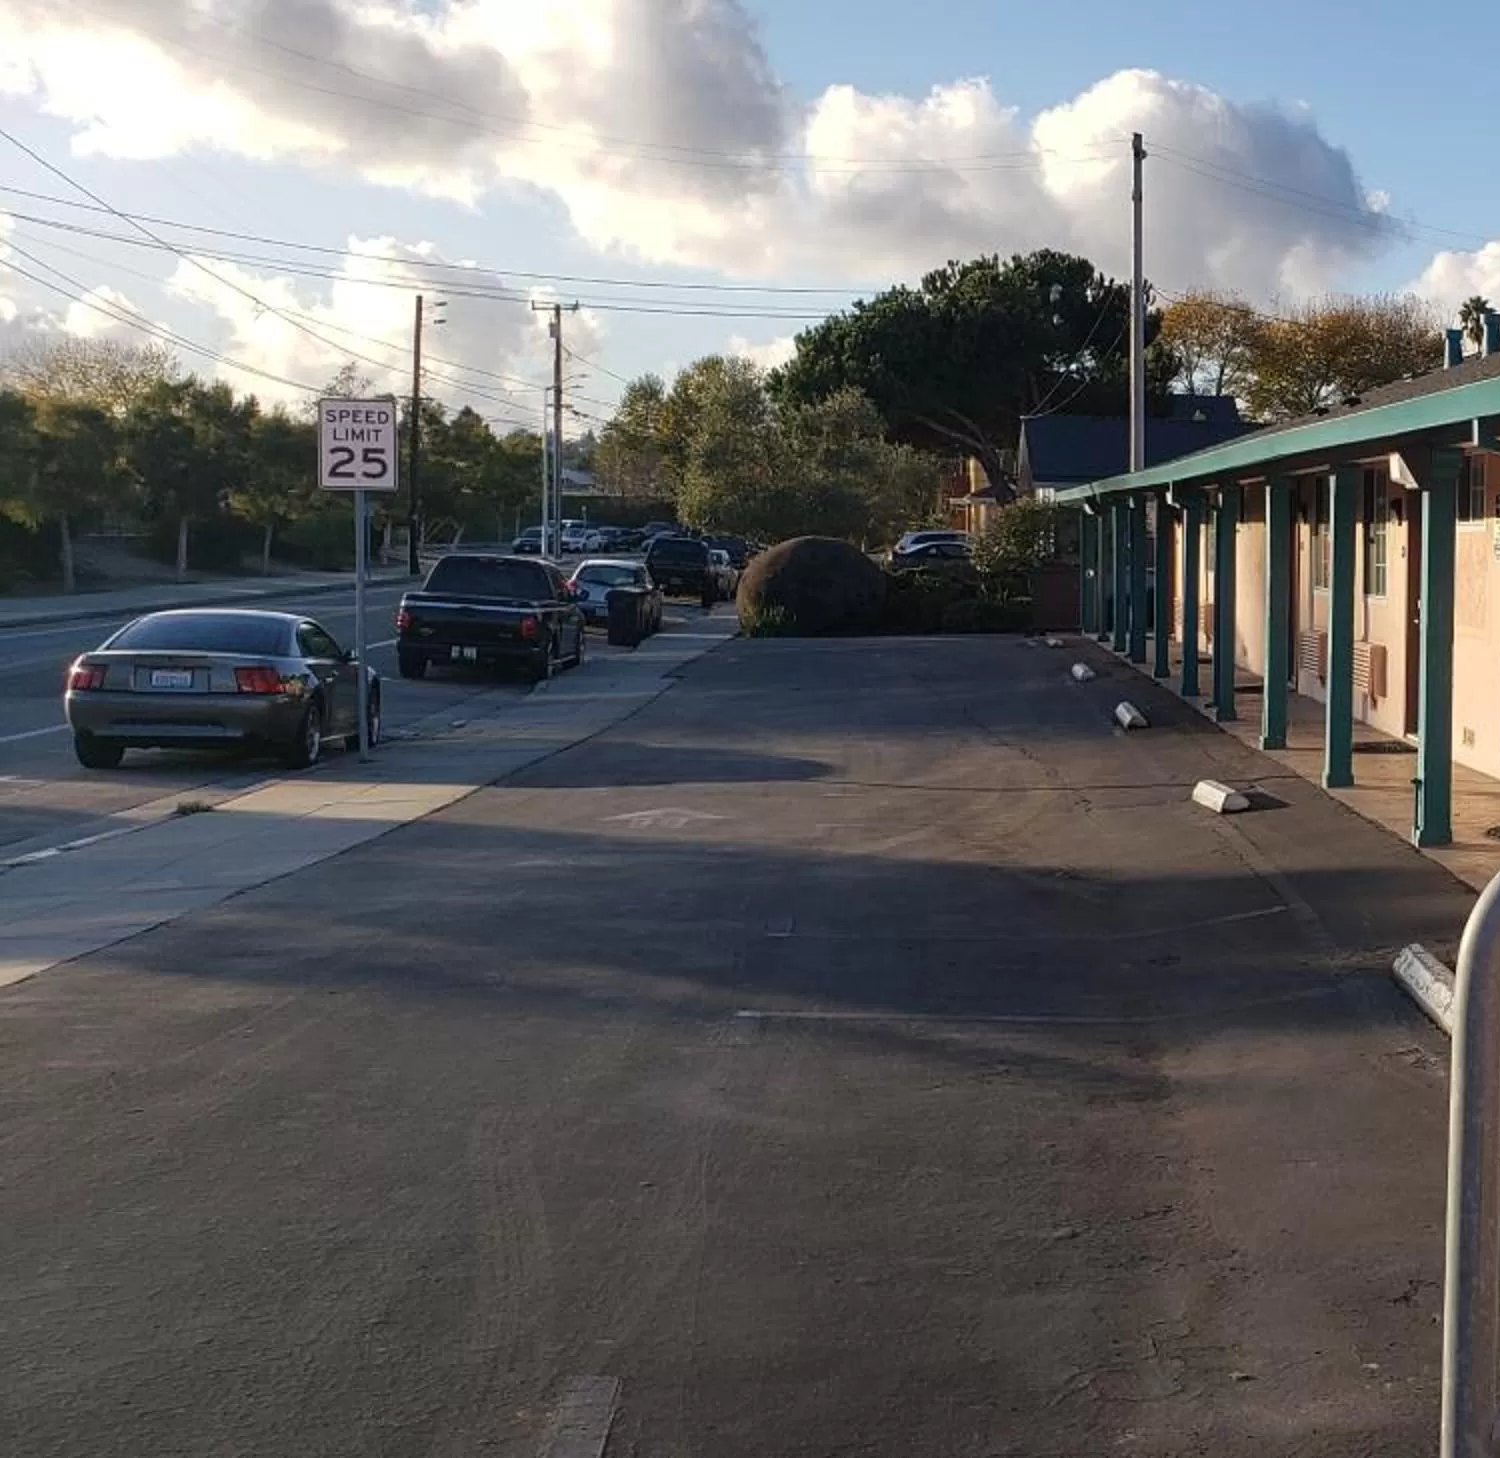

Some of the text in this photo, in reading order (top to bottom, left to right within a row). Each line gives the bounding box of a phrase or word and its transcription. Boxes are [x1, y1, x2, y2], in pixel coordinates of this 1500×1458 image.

[325, 409, 389, 424] SPEED
[333, 427, 382, 442] LIMIT
[328, 446, 388, 479] 25
